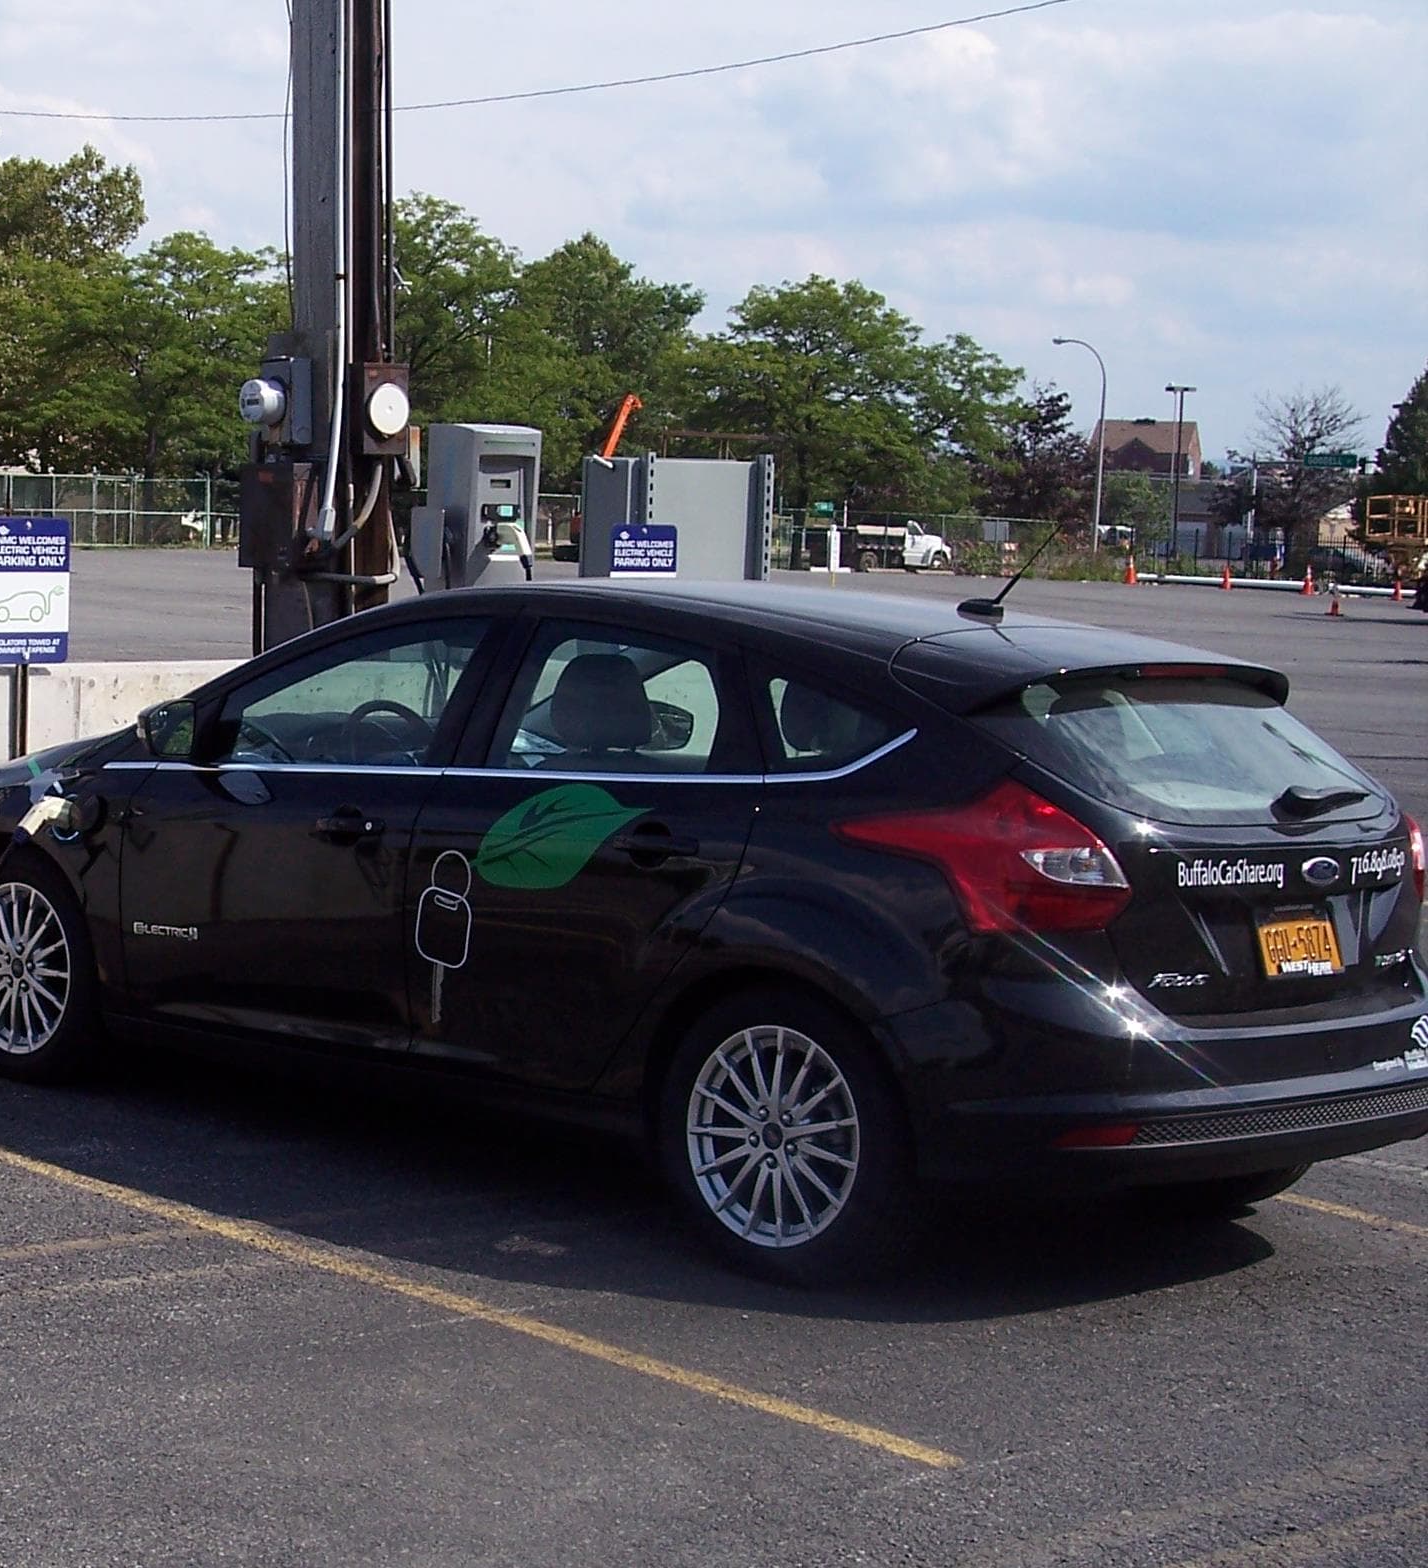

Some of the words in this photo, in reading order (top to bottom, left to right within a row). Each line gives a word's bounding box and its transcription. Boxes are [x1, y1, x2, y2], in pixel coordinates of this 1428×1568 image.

[19, 536, 66, 545] WELCOMES
[636, 540, 674, 548] WELCOMES
[32, 546, 65, 555] VEHICLE
[614, 548, 645, 557] ELECTRIC
[646, 549, 673, 557] VEHICLE
[38, 556, 66, 566] ONLY
[614, 557, 650, 567] PARKING
[652, 558, 674, 567] ONLY
[1178, 857, 1284, 888] BuffaloCarShare.org
[133, 921, 189, 938] ELECTRIC
[1280, 960, 1308, 973] WEST
